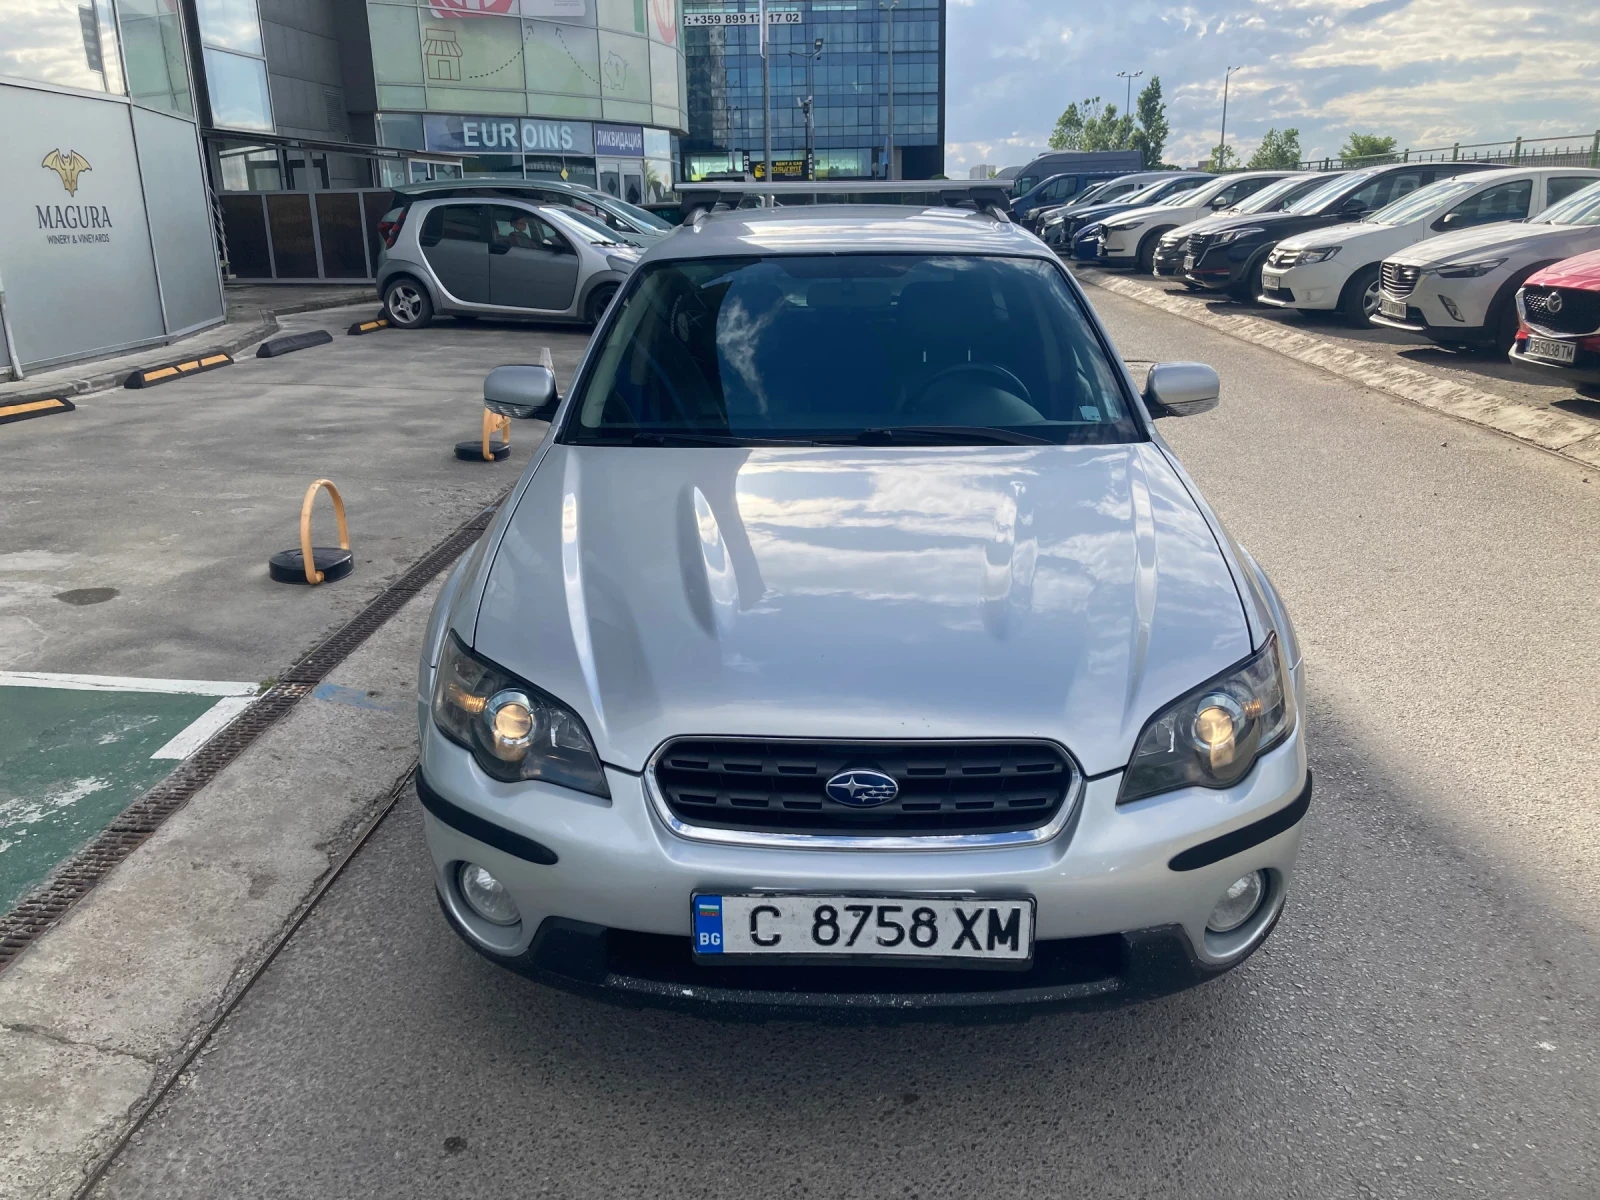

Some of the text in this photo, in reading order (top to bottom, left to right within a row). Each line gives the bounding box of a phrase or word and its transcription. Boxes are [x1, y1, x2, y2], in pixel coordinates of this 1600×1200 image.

[693, 15, 721, 24] +359
[725, 14, 746, 24] 899
[768, 13, 782, 23] 17
[785, 13, 800, 22] 02
[462, 122, 573, 149] EUROINS
[597, 130, 642, 151] ЛИКВИДАЦИЯ
[35, 205, 113, 229] MAGURA
[47, 233, 110, 245] WINERY & VINEYARDS
[1540, 341, 1560, 357] 5038
[1561, 345, 1574, 360] TM
[811, 905, 938, 948] 8758
[699, 932, 721, 946] BG
